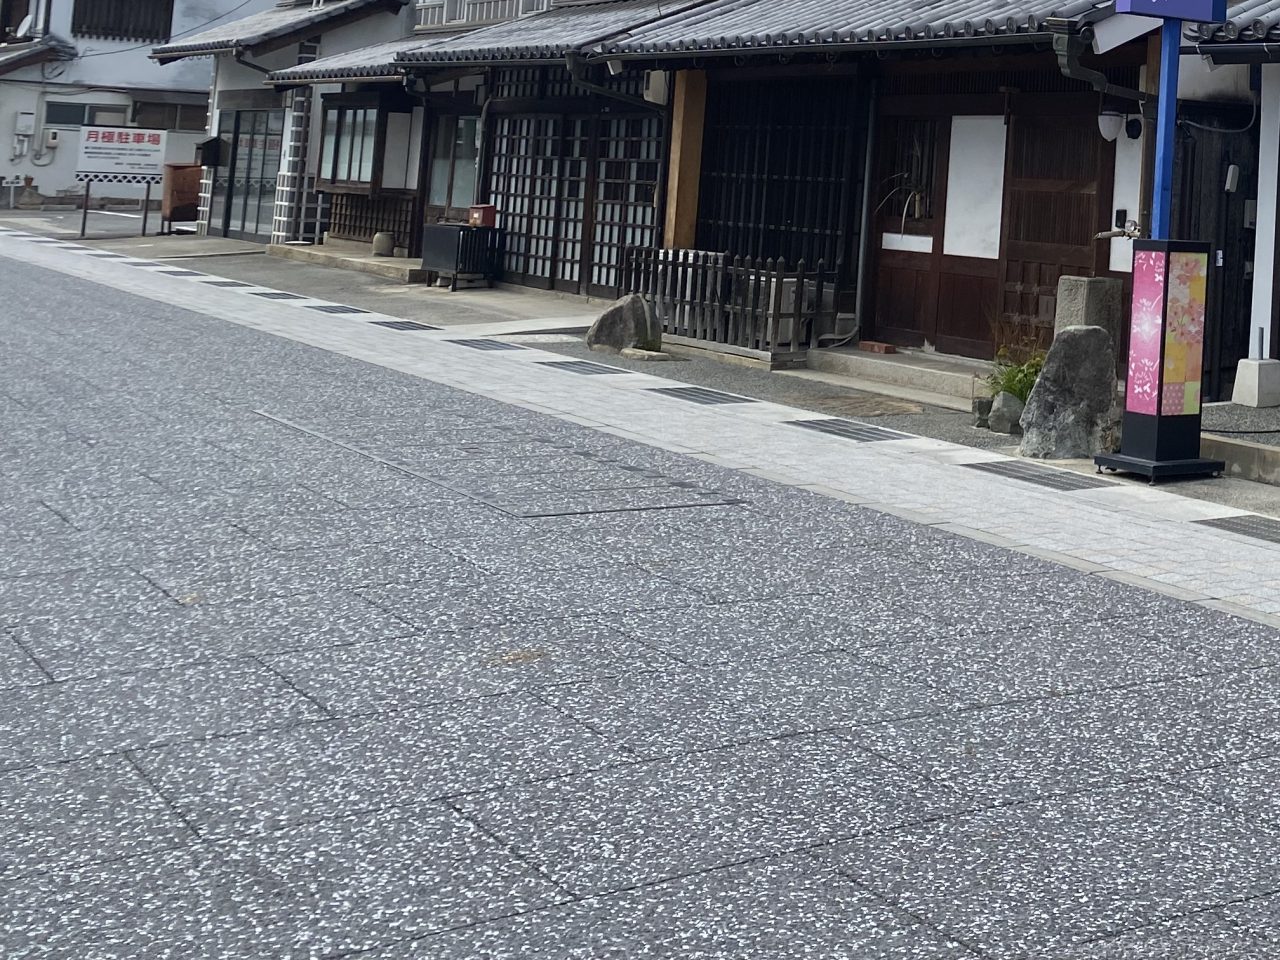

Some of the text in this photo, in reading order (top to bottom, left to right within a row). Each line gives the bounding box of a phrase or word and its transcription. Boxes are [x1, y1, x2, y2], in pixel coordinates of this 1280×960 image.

[86, 130, 161, 145] 月極駐車場
